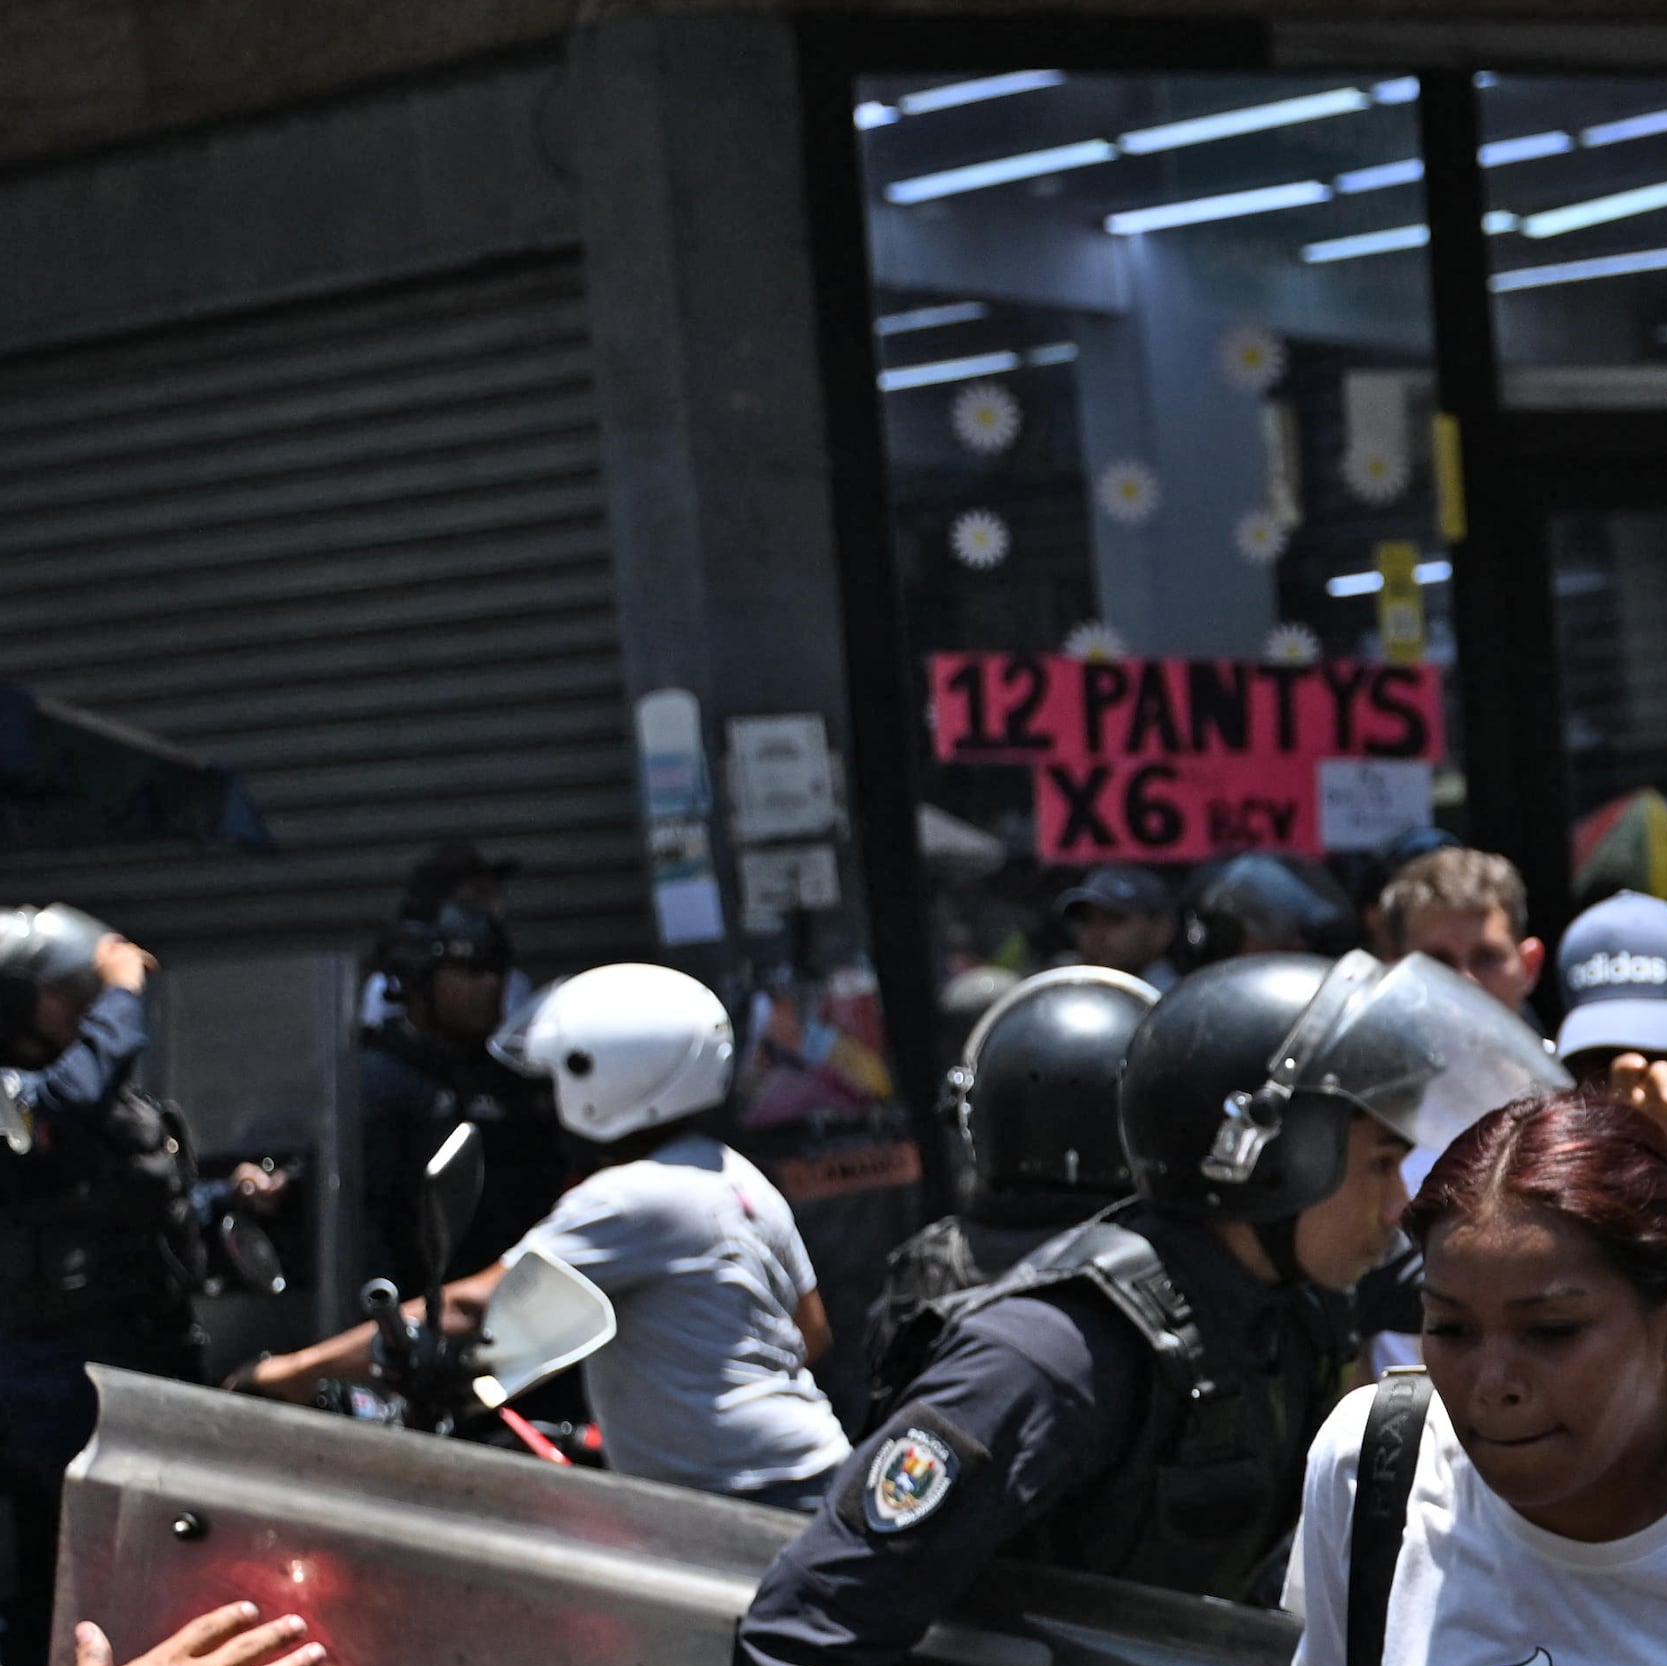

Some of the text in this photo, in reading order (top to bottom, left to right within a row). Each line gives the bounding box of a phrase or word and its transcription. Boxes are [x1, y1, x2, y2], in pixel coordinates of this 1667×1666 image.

[946, 660, 1431, 759] 12 PANTYS
[1047, 764, 1185, 851] X6
